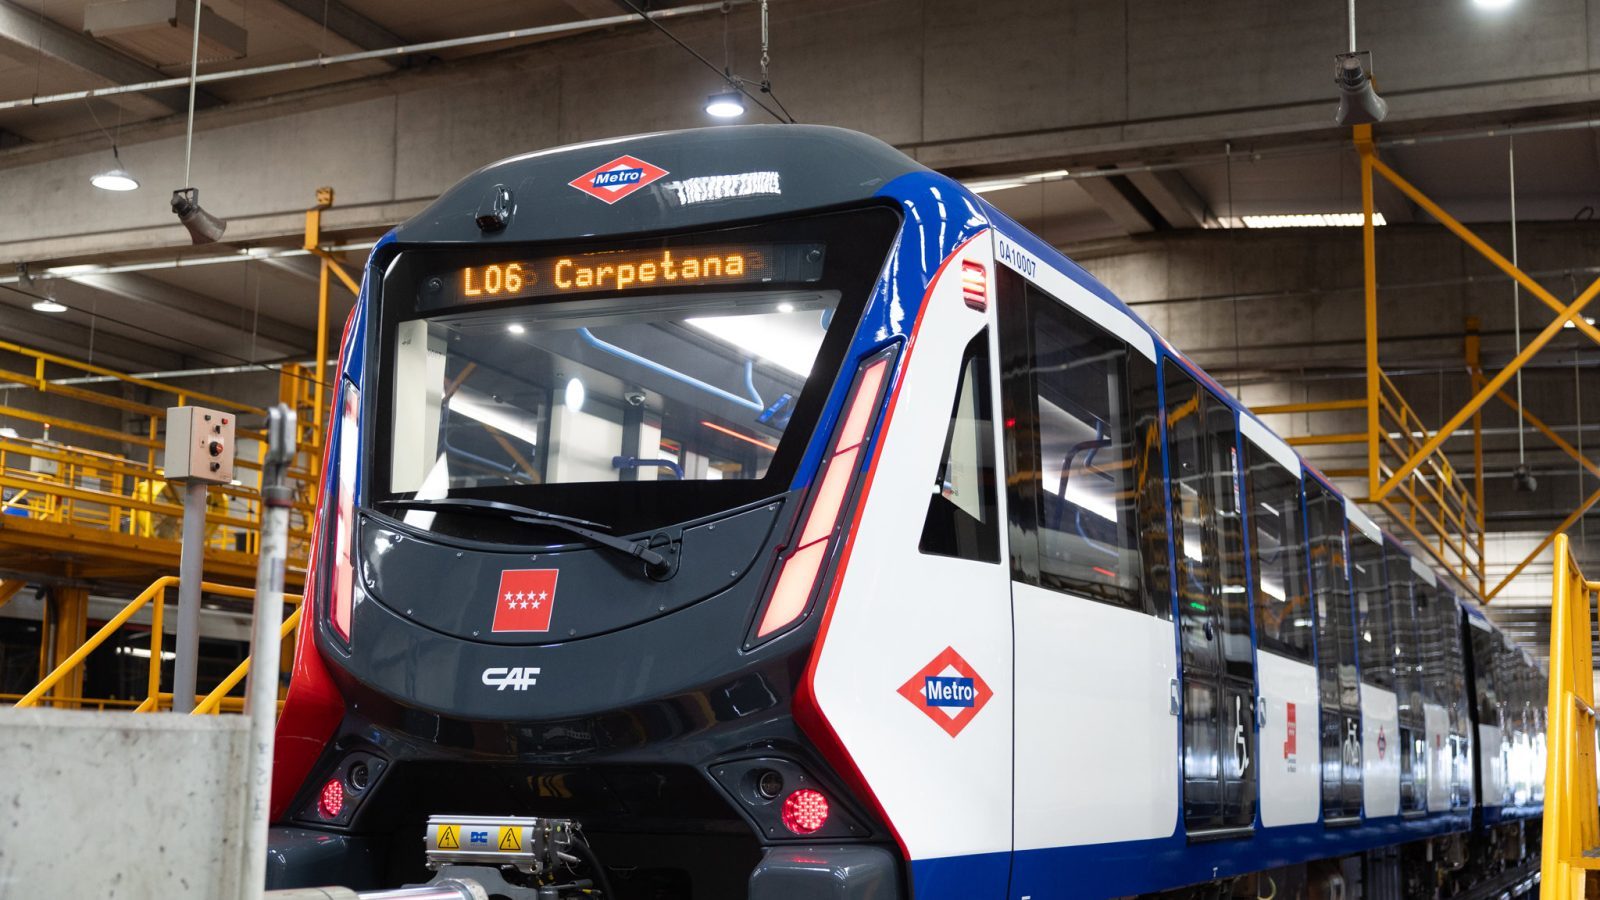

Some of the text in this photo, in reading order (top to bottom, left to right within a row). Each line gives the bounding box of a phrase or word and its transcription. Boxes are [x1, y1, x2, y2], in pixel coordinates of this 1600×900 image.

[595, 170, 640, 185] Metro
[999, 240, 1036, 278] 0A10007
[464, 250, 745, 296] L06 Carpetana
[481, 667, 541, 691] CAF
[927, 680, 973, 701] Metro
